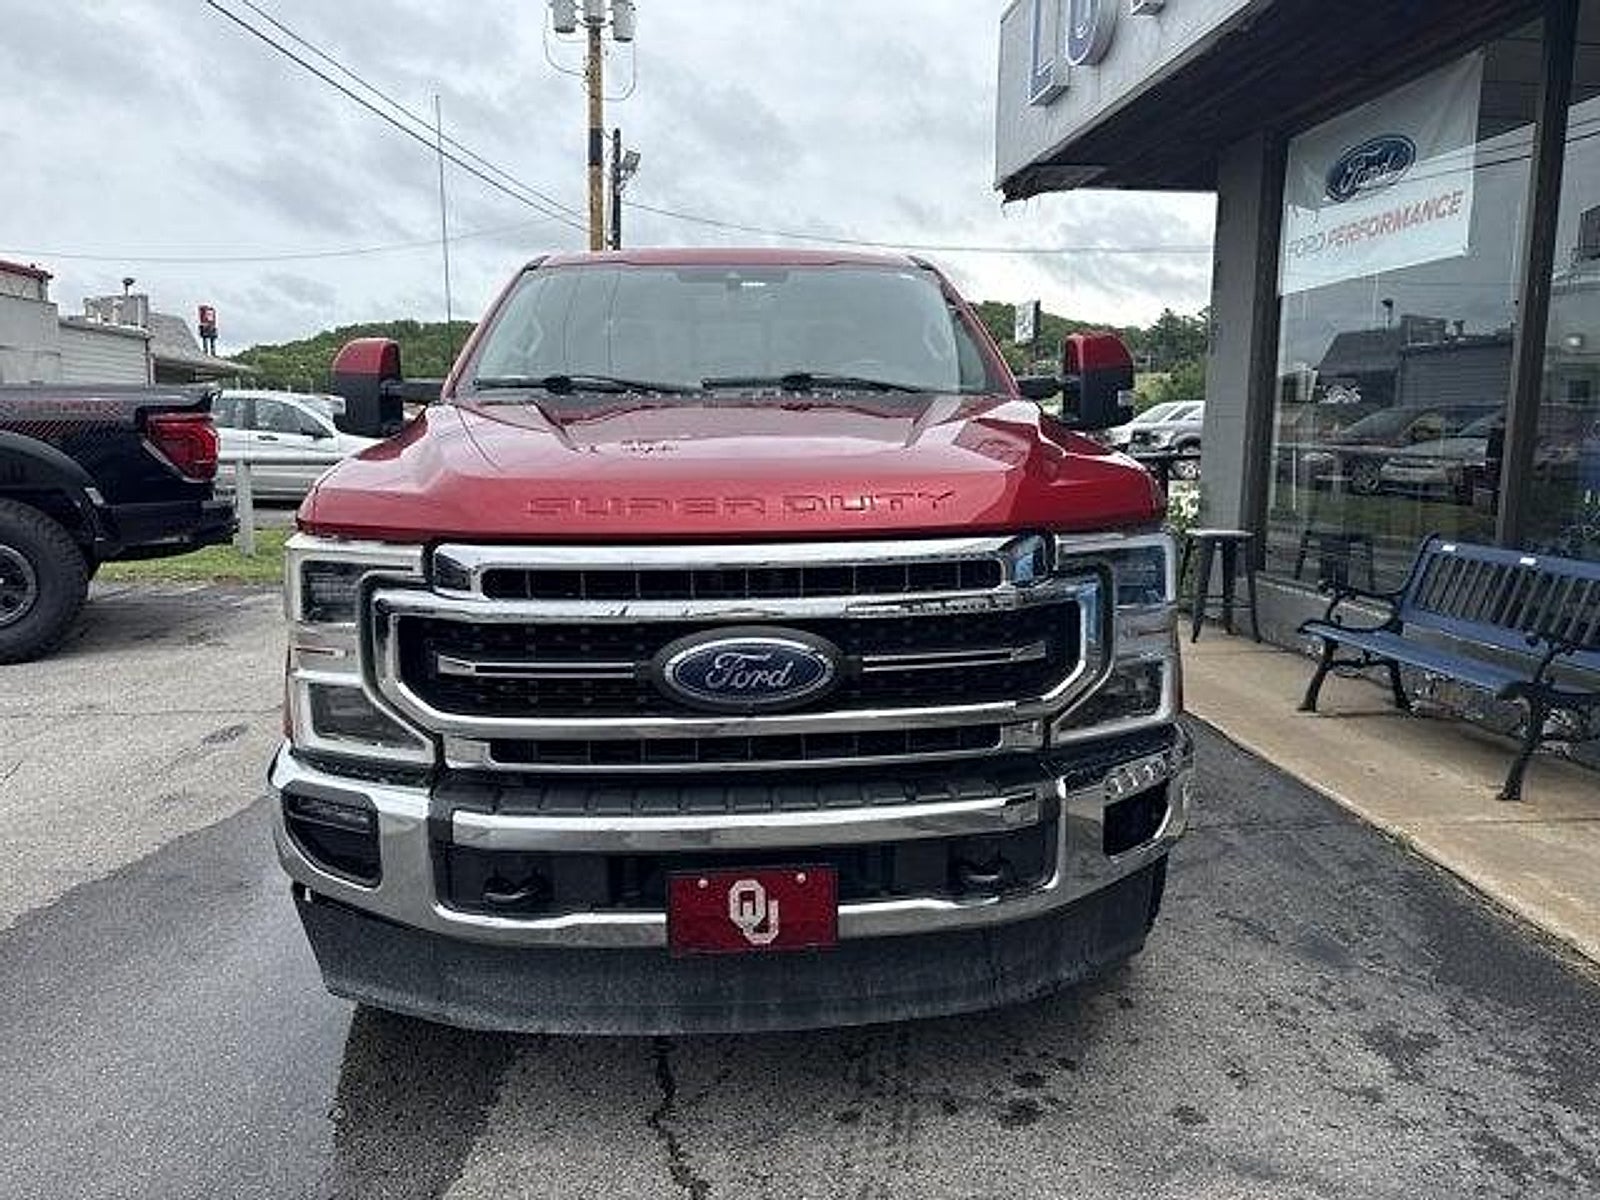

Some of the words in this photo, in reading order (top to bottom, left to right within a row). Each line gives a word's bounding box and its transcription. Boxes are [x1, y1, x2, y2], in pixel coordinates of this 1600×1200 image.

[1326, 190, 1464, 247] PERFORMANCE
[525, 496, 766, 515] SUPER
[784, 491, 955, 512] DUTY
[704, 652, 795, 689] Ford
